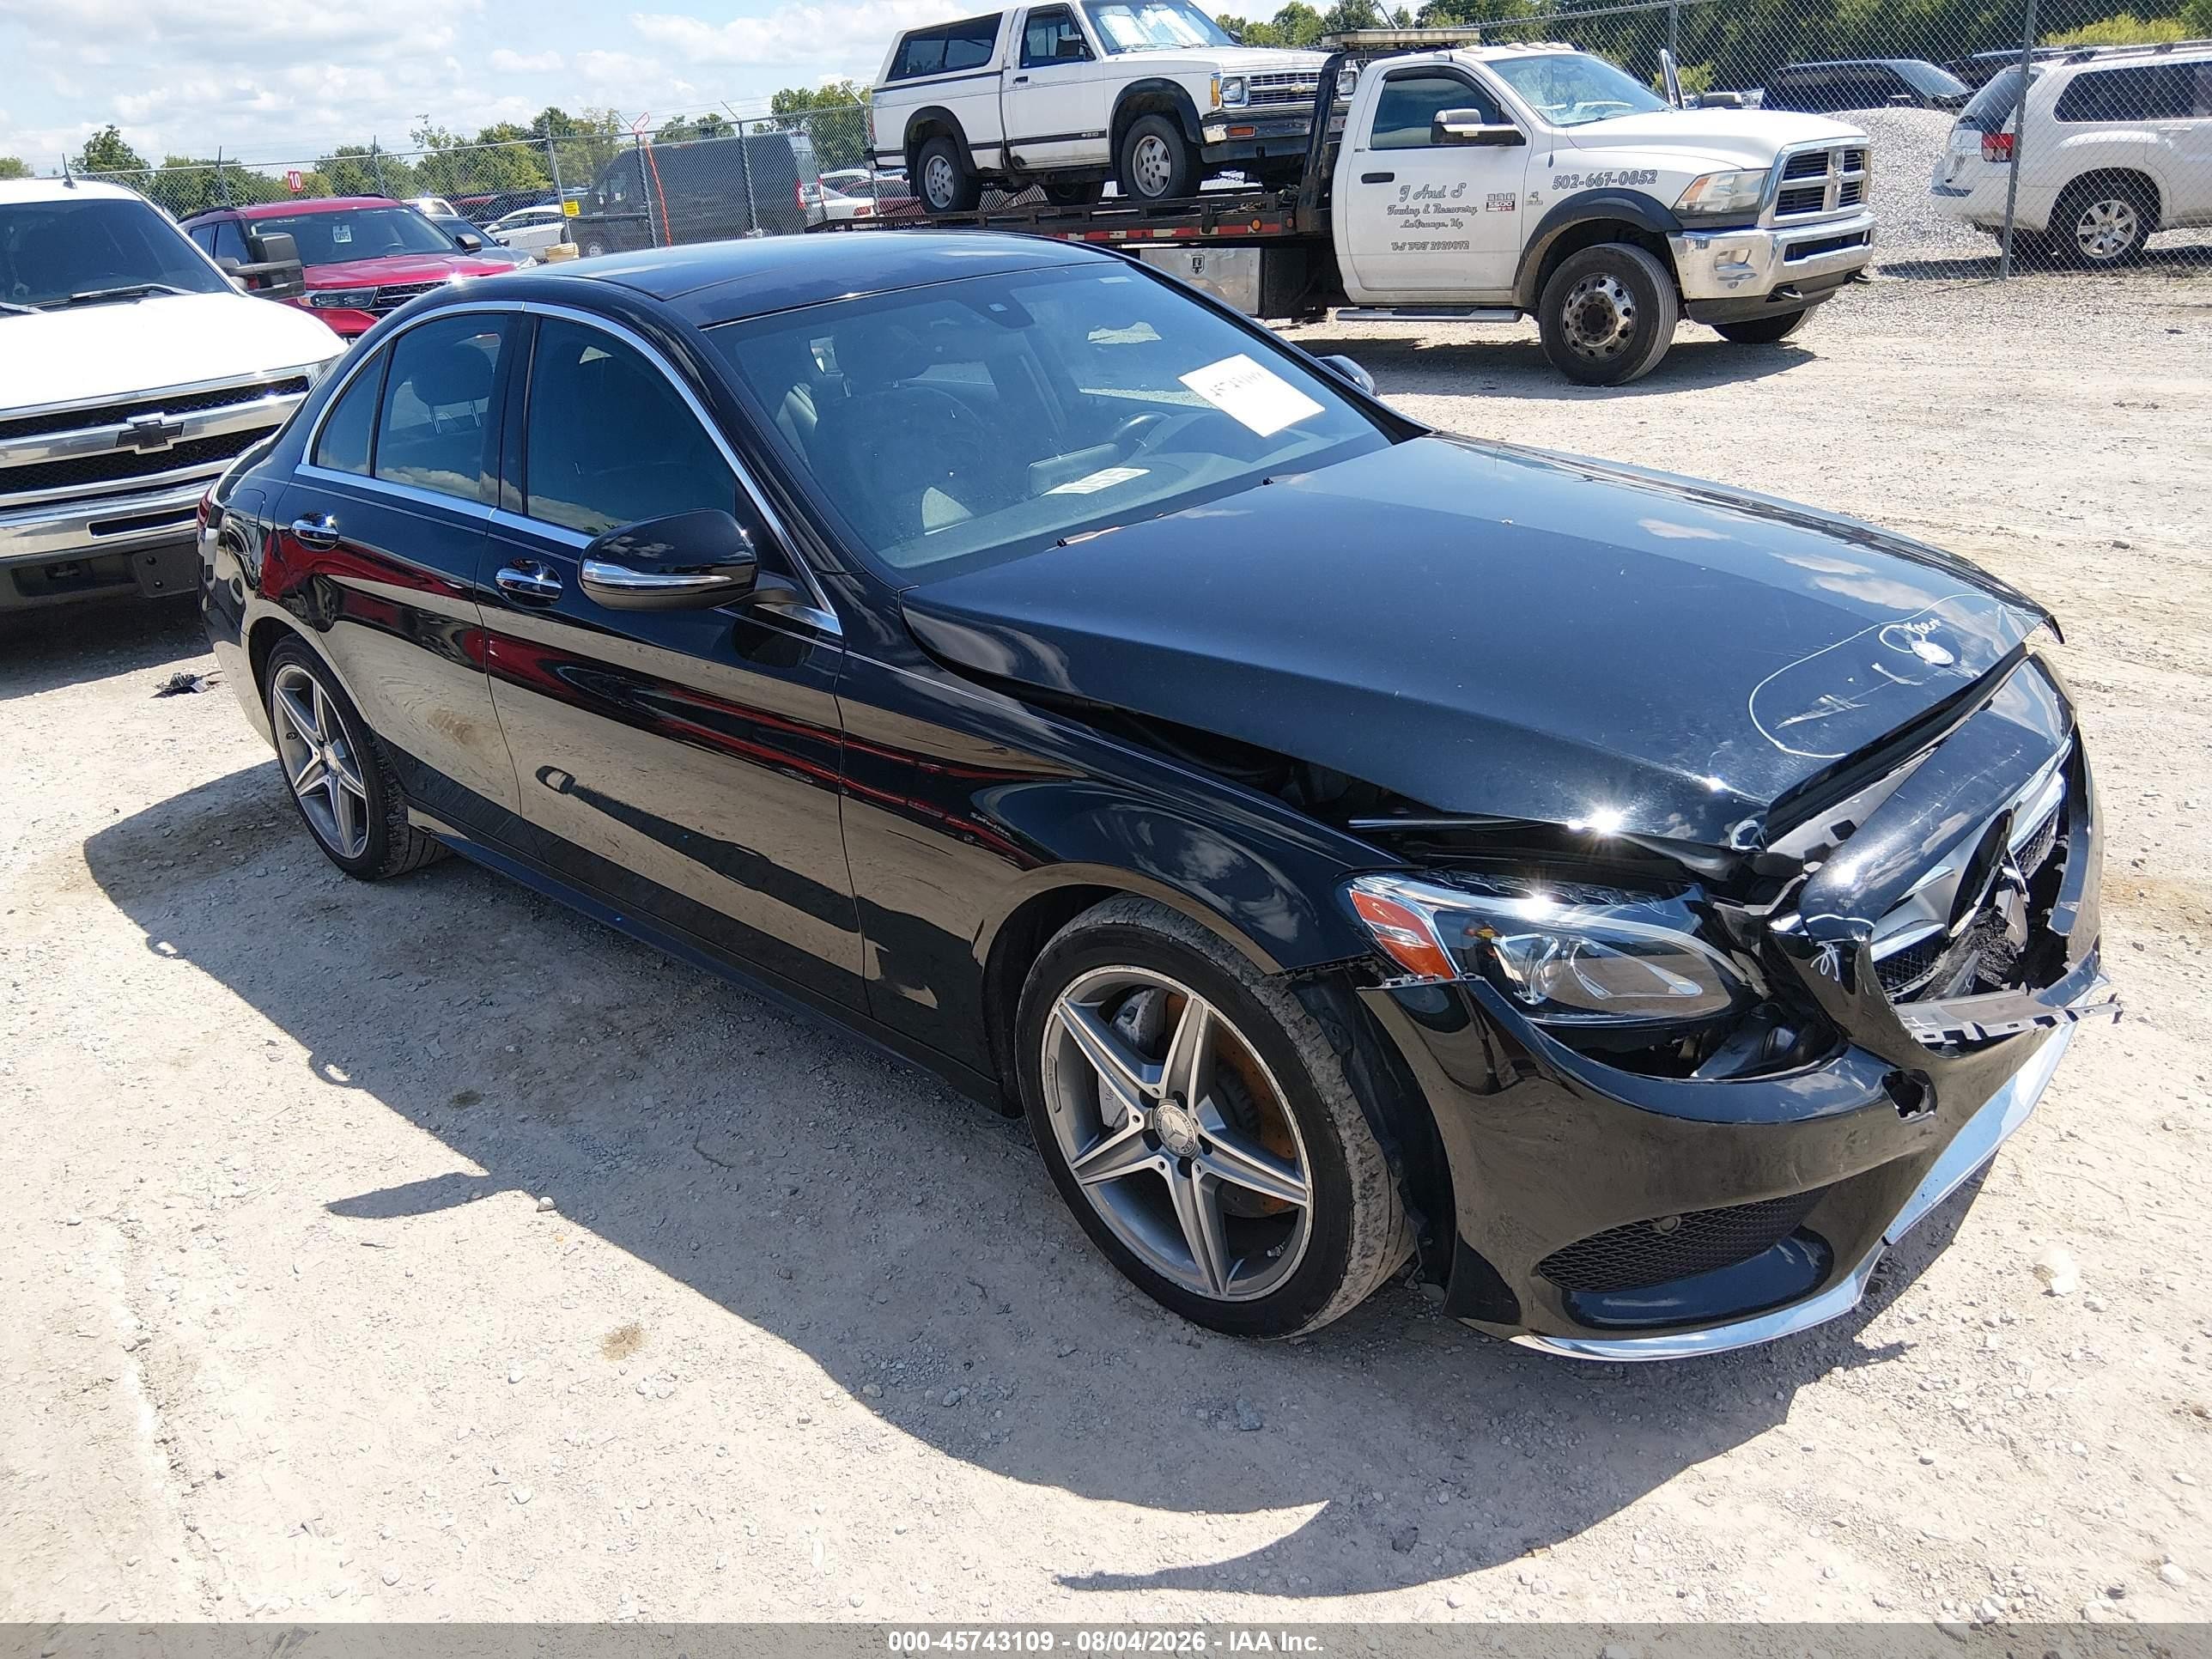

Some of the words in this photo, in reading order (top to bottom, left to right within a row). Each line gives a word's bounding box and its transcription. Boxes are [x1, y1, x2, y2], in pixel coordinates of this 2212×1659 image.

[289, 173, 301, 189] 10
[1552, 169, 1658, 190] 502-667-0852
[1413, 184, 1447, 201] And
[1450, 182, 1467, 199] S
[1387, 204, 1421, 218] Towing
[1422, 204, 1431, 215] &
[1432, 203, 1478, 216] Recovery
